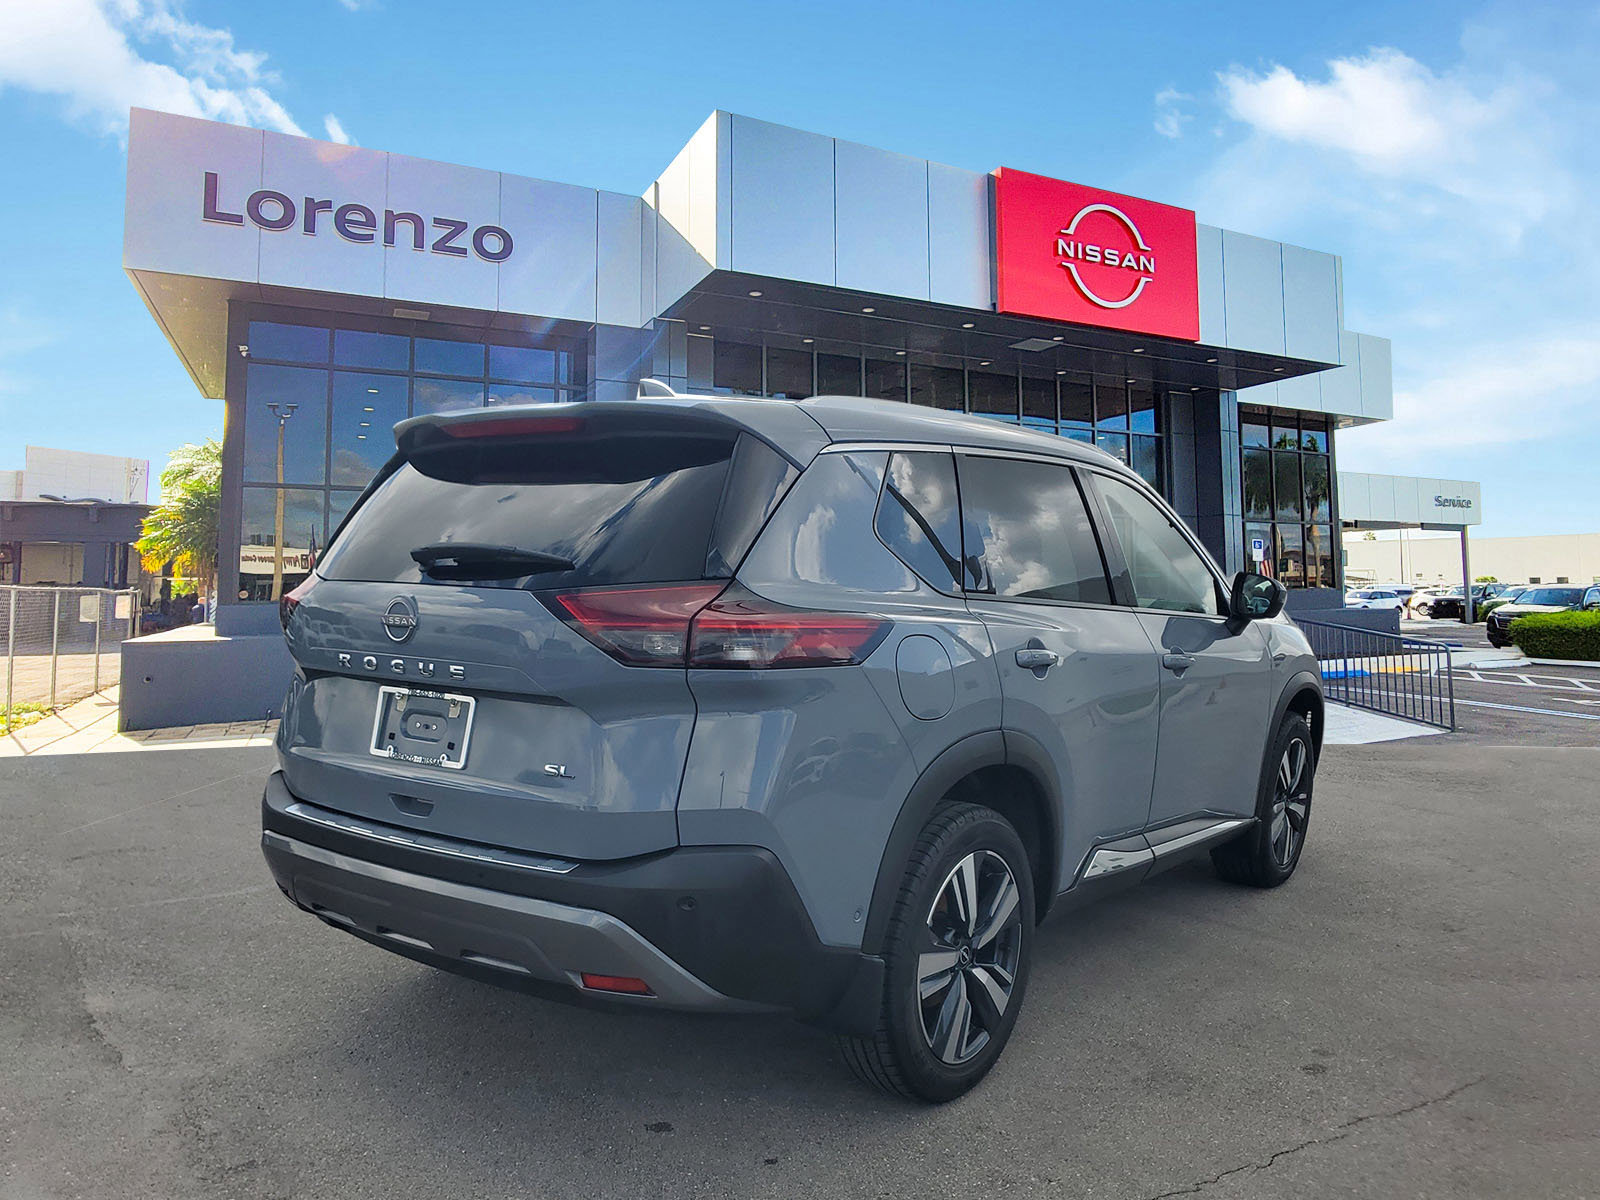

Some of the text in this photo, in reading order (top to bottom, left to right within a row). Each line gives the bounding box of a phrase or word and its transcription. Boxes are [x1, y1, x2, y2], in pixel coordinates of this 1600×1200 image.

[202, 171, 514, 262] Lorenzo
[1057, 238, 1155, 273] NISSAN
[1434, 495, 1472, 509] Service
[381, 615, 417, 627] NISSAN
[338, 653, 466, 681] ROGUE
[544, 764, 575, 779] SL
